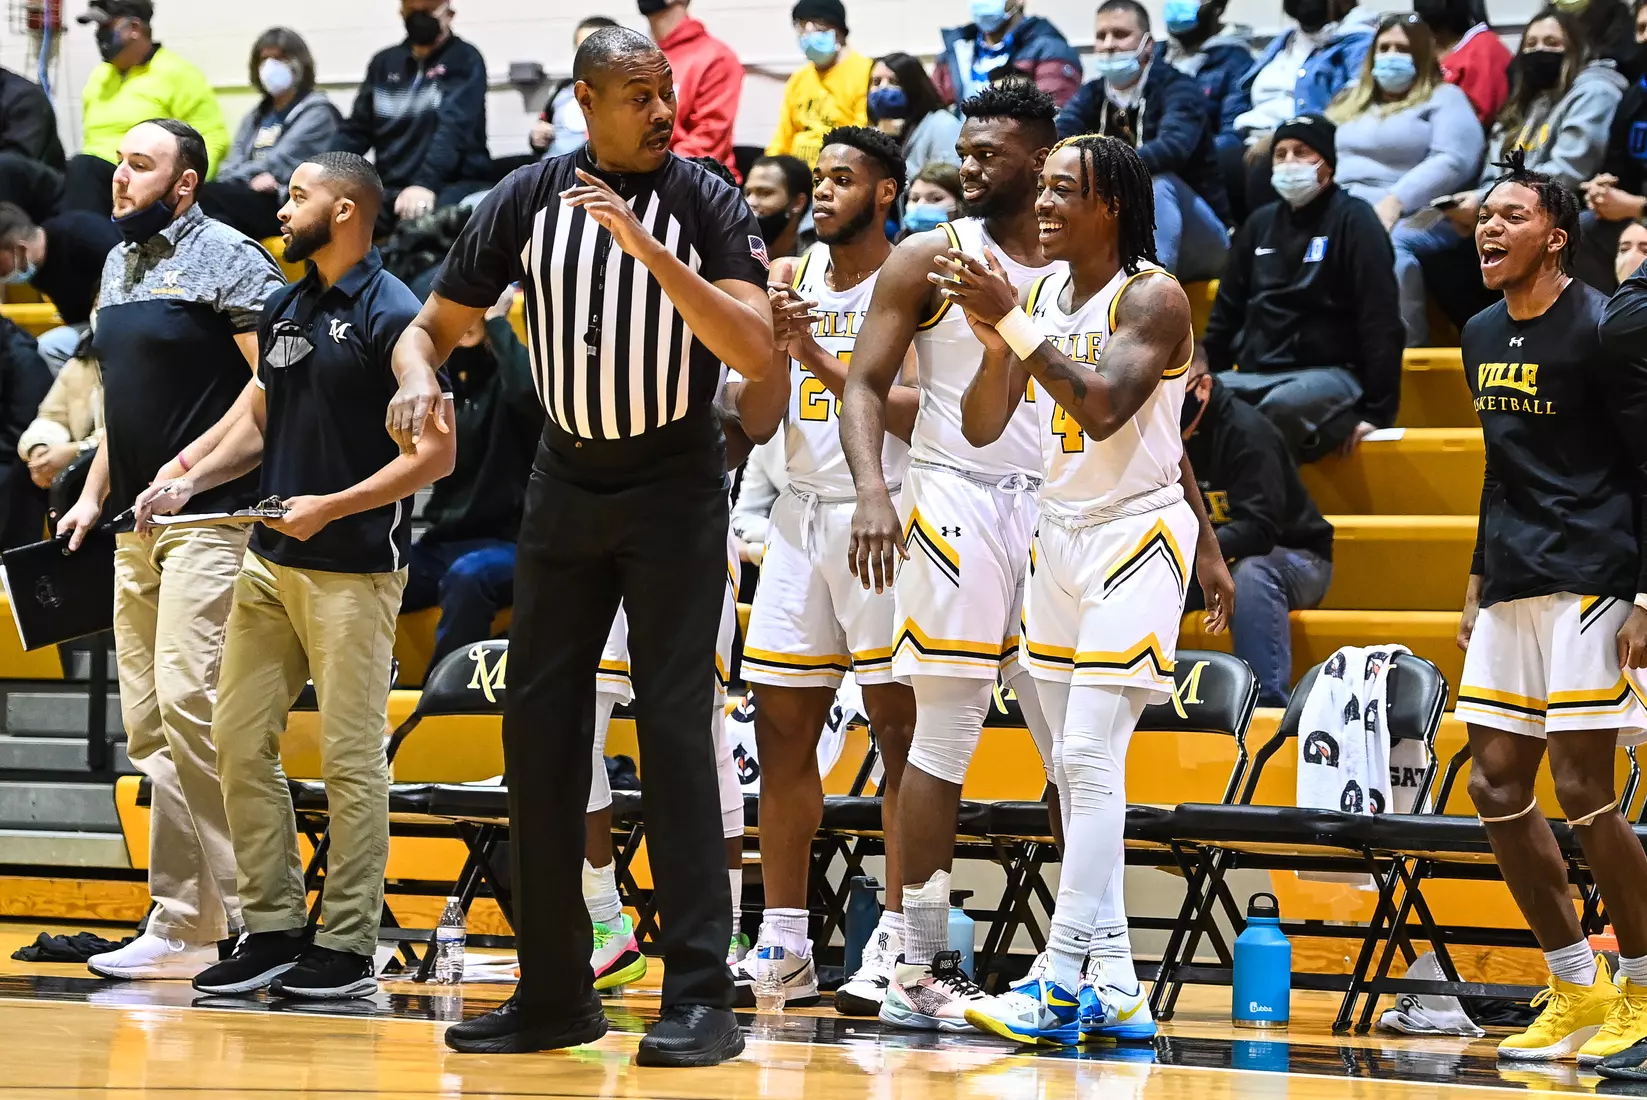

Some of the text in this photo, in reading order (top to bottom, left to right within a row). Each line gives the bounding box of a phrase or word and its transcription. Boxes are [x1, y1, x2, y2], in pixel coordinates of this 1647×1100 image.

[1478, 363, 1539, 396] VILLE
[1473, 396, 1557, 415] SKETBALL
[1051, 401, 1084, 453] 4
